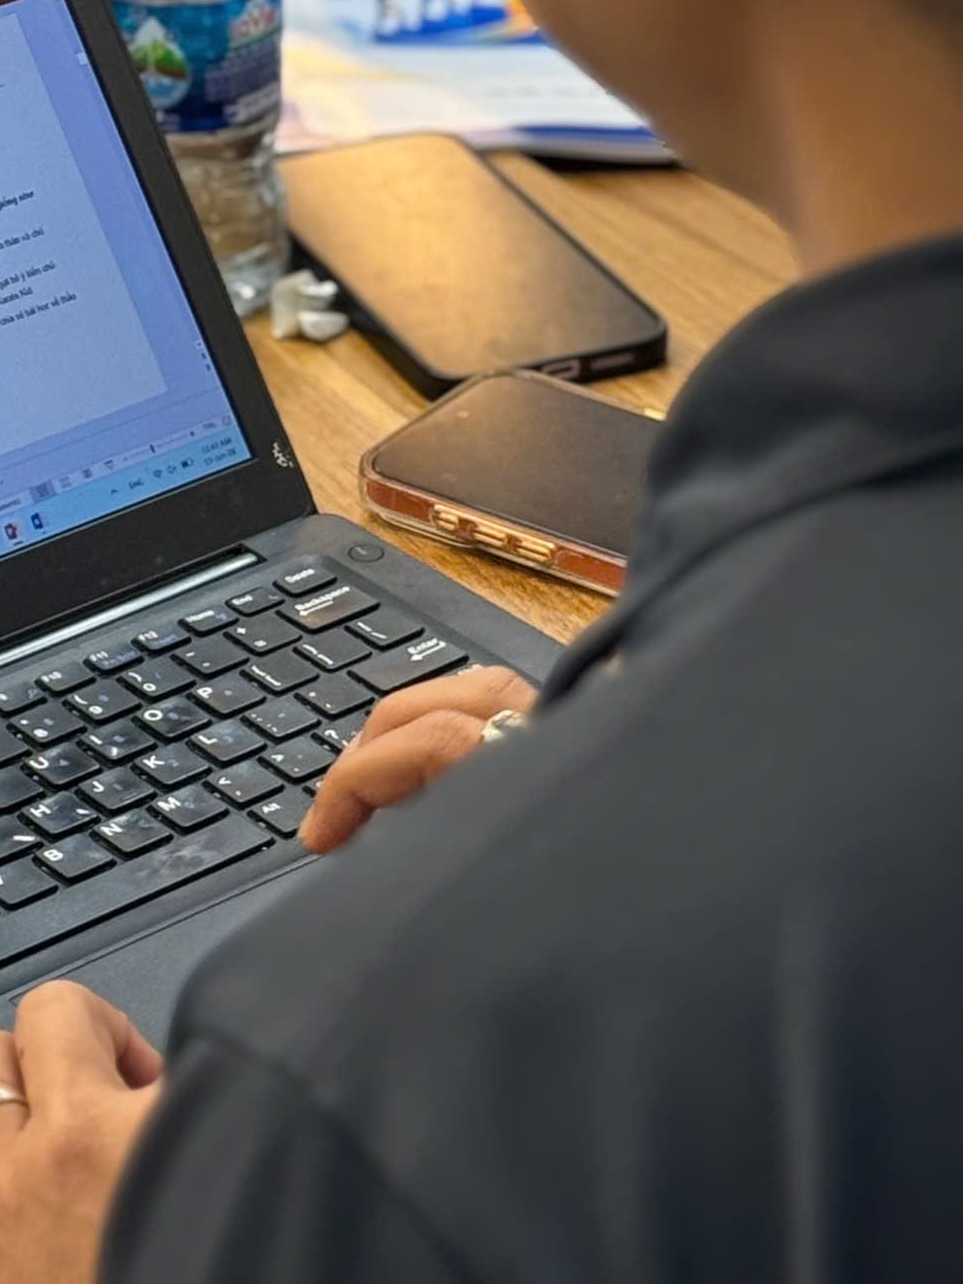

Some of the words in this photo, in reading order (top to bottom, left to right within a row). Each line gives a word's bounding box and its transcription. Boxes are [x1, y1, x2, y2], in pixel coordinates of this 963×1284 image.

[293, 586, 350, 612] Backspace
[196, 686, 214, 699] P
[142, 709, 164, 722] O
[197, 733, 218, 746] L
[28, 756, 50, 770] U
[141, 754, 166, 769] K
[91, 780, 105, 793] J
[29, 803, 52, 818] H
[156, 796, 182, 812] M
[260, 801, 282, 815] Alt
[100, 822, 124, 837] N
[42, 848, 64, 862] B
